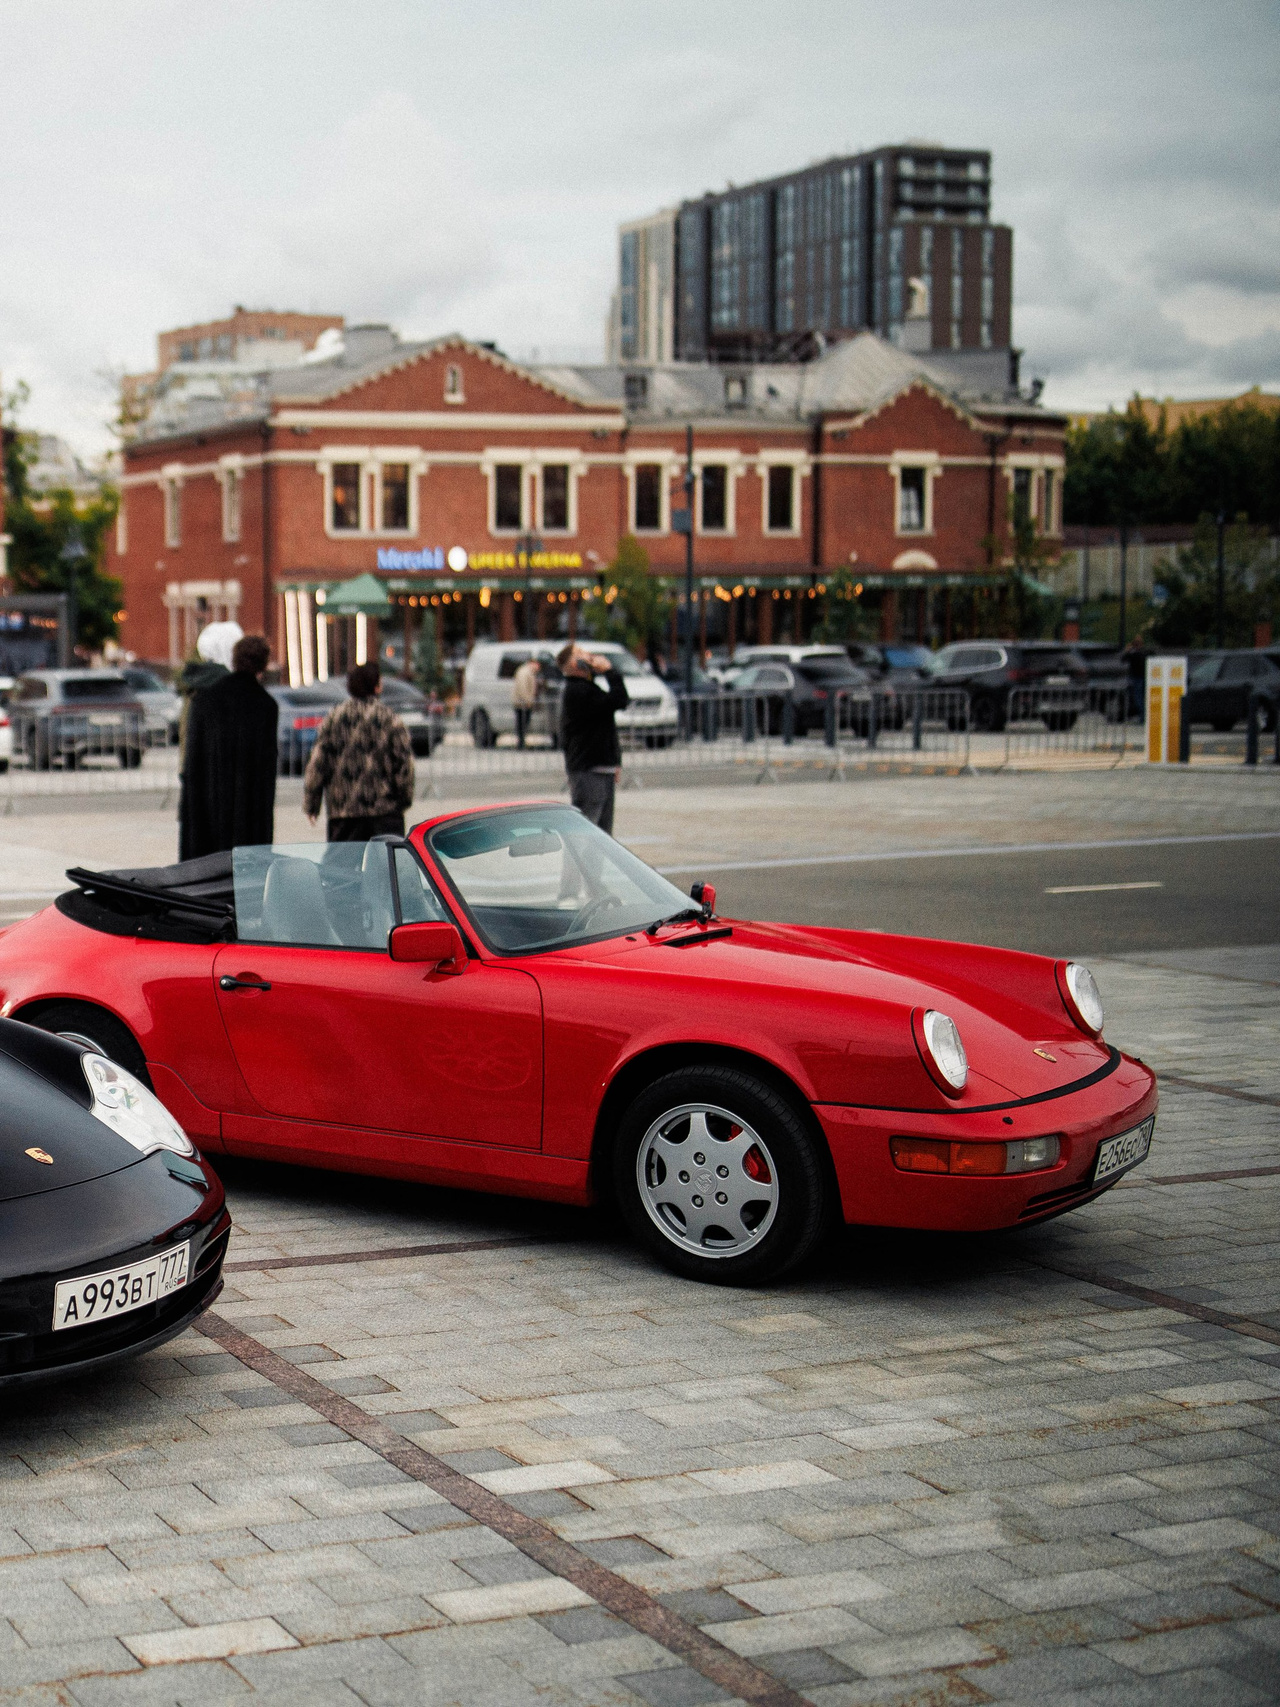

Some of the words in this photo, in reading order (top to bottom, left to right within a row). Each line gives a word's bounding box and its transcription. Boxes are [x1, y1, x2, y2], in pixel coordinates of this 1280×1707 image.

[63, 1270, 157, 1323] A993BT
[161, 1248, 186, 1283] 777
[164, 1277, 179, 1292] RUS
